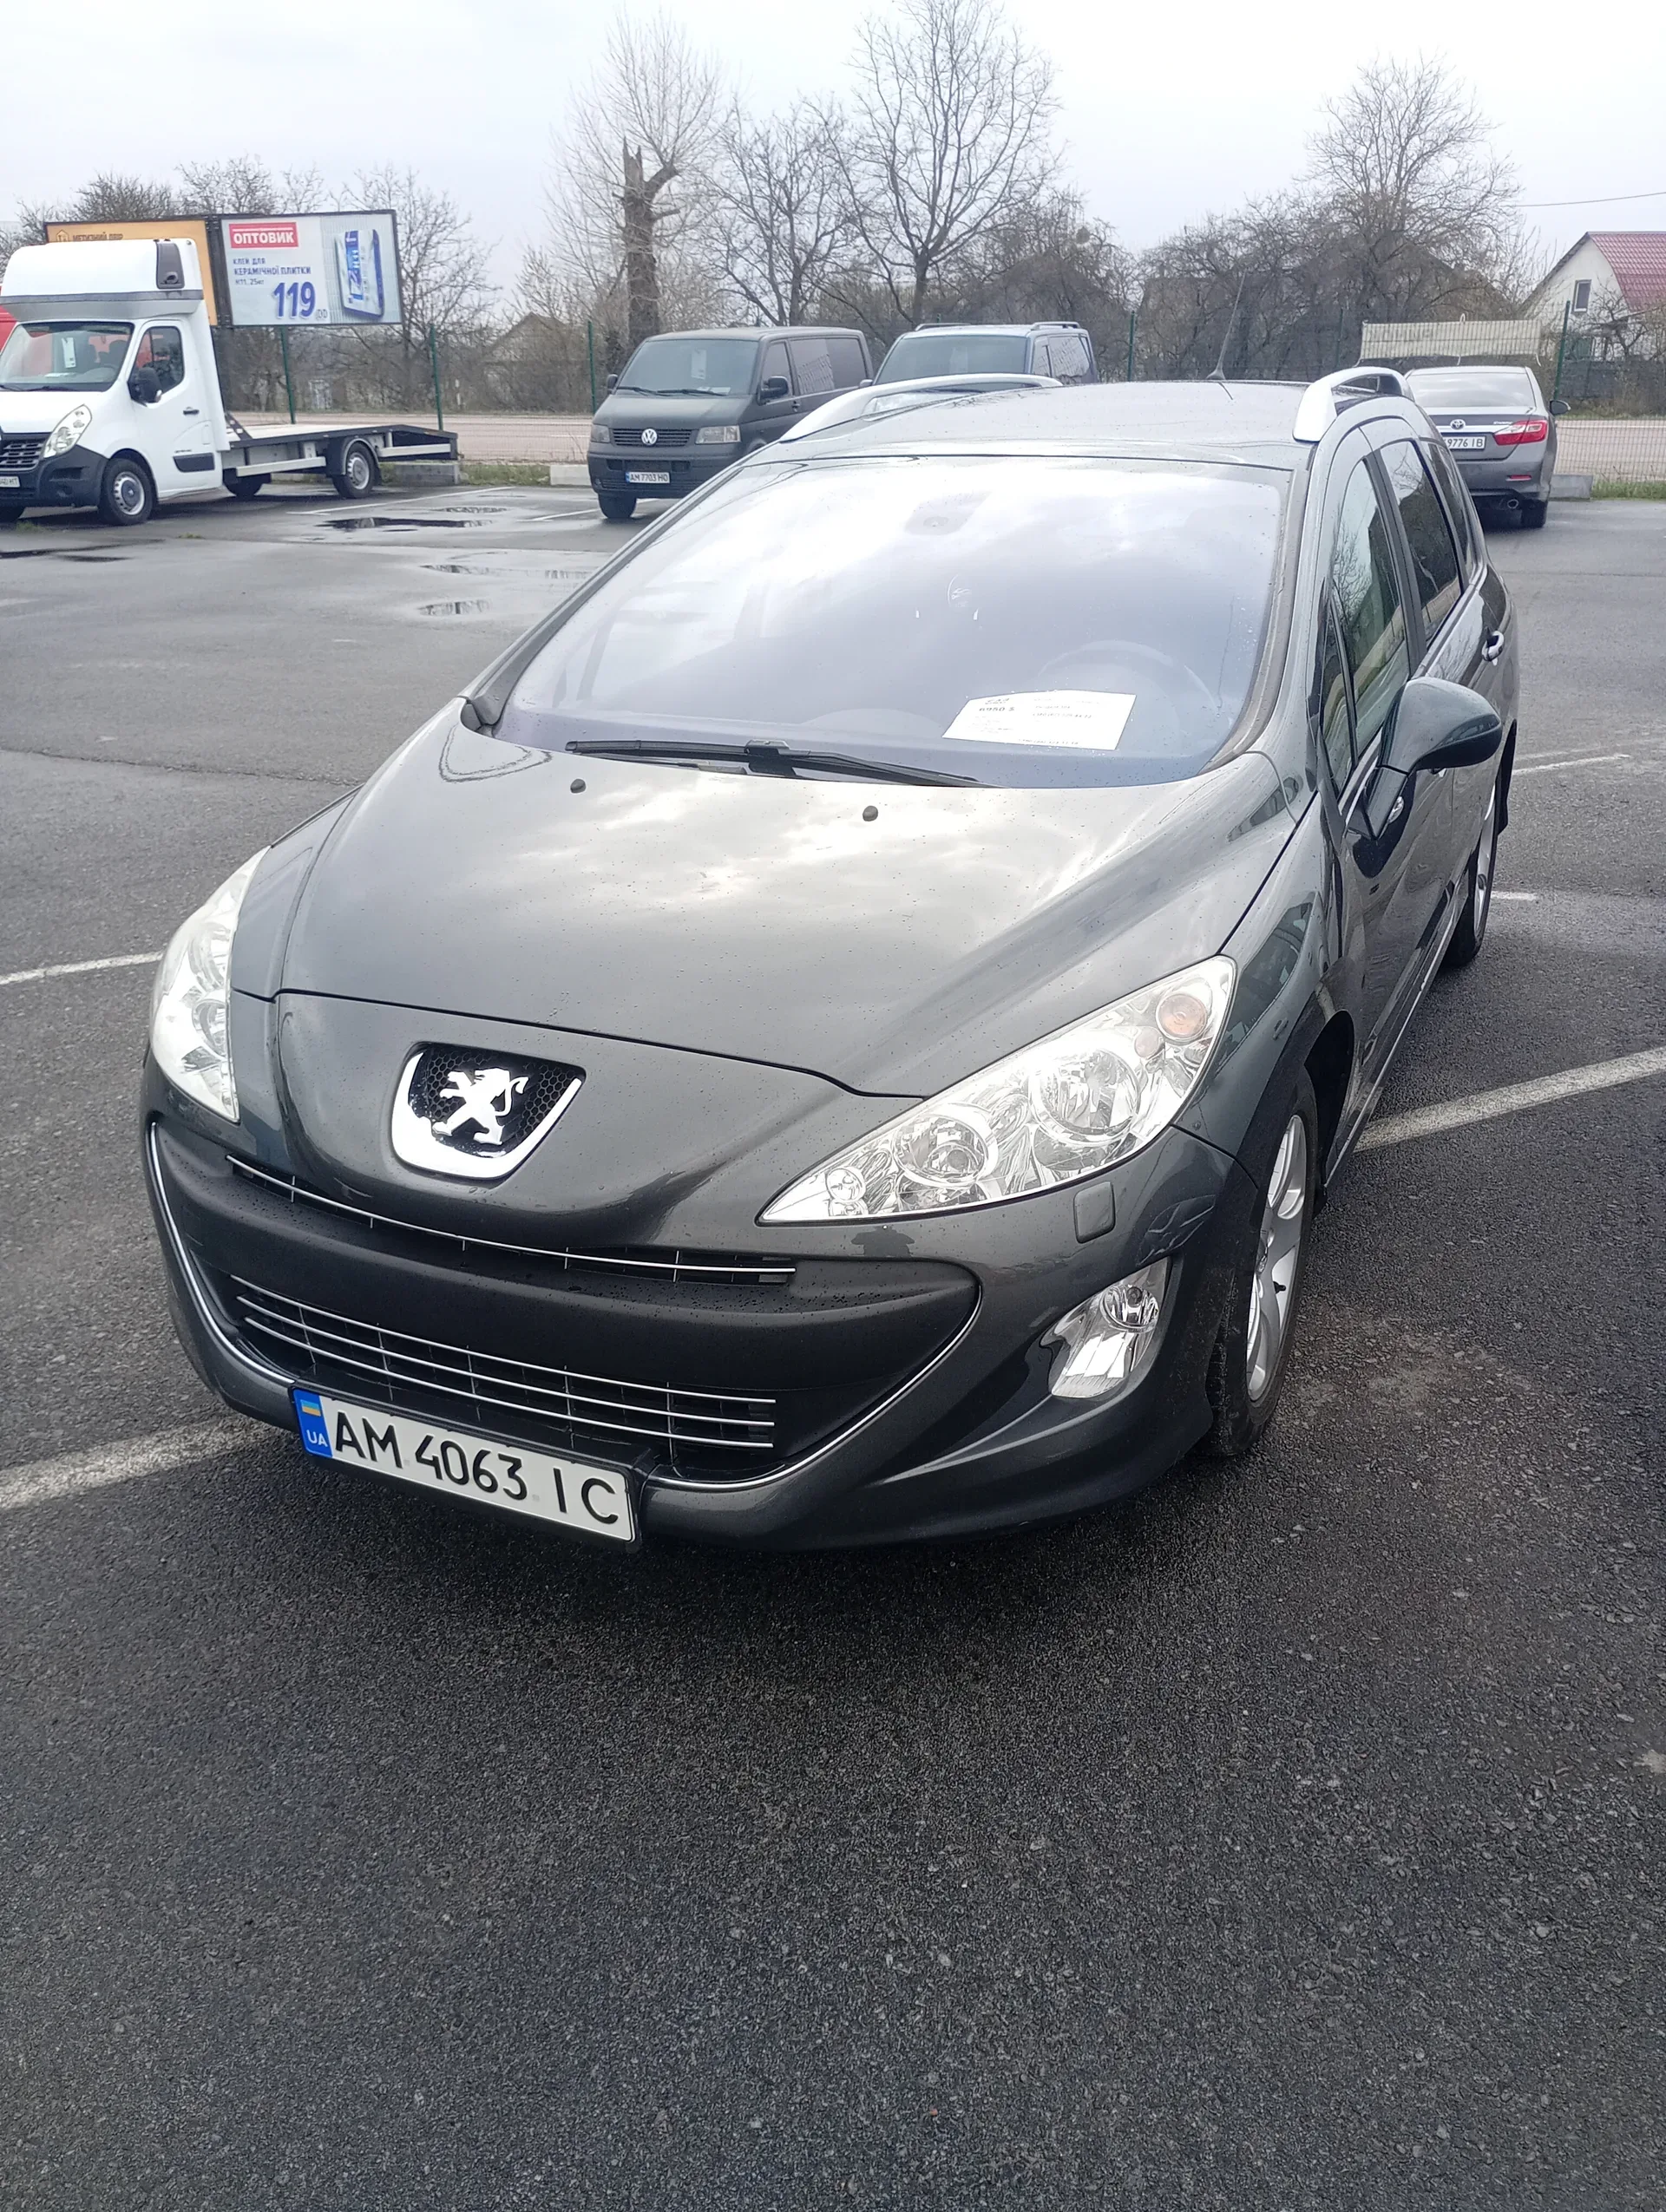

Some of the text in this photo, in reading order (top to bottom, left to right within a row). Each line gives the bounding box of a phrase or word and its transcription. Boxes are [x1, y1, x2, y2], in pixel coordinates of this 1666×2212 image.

[233, 232, 294, 244] ОПТОВИК
[233, 265, 312, 276] КЕРАМІЧНОЇ ПЛИТКИ
[273, 281, 316, 317] 119
[1447, 438, 1468, 448] 9776
[1472, 438, 1484, 447] IB
[640, 473, 657, 482] 7703
[307, 1429, 329, 1449] UA
[334, 1410, 620, 1525] AM 4063 IC
